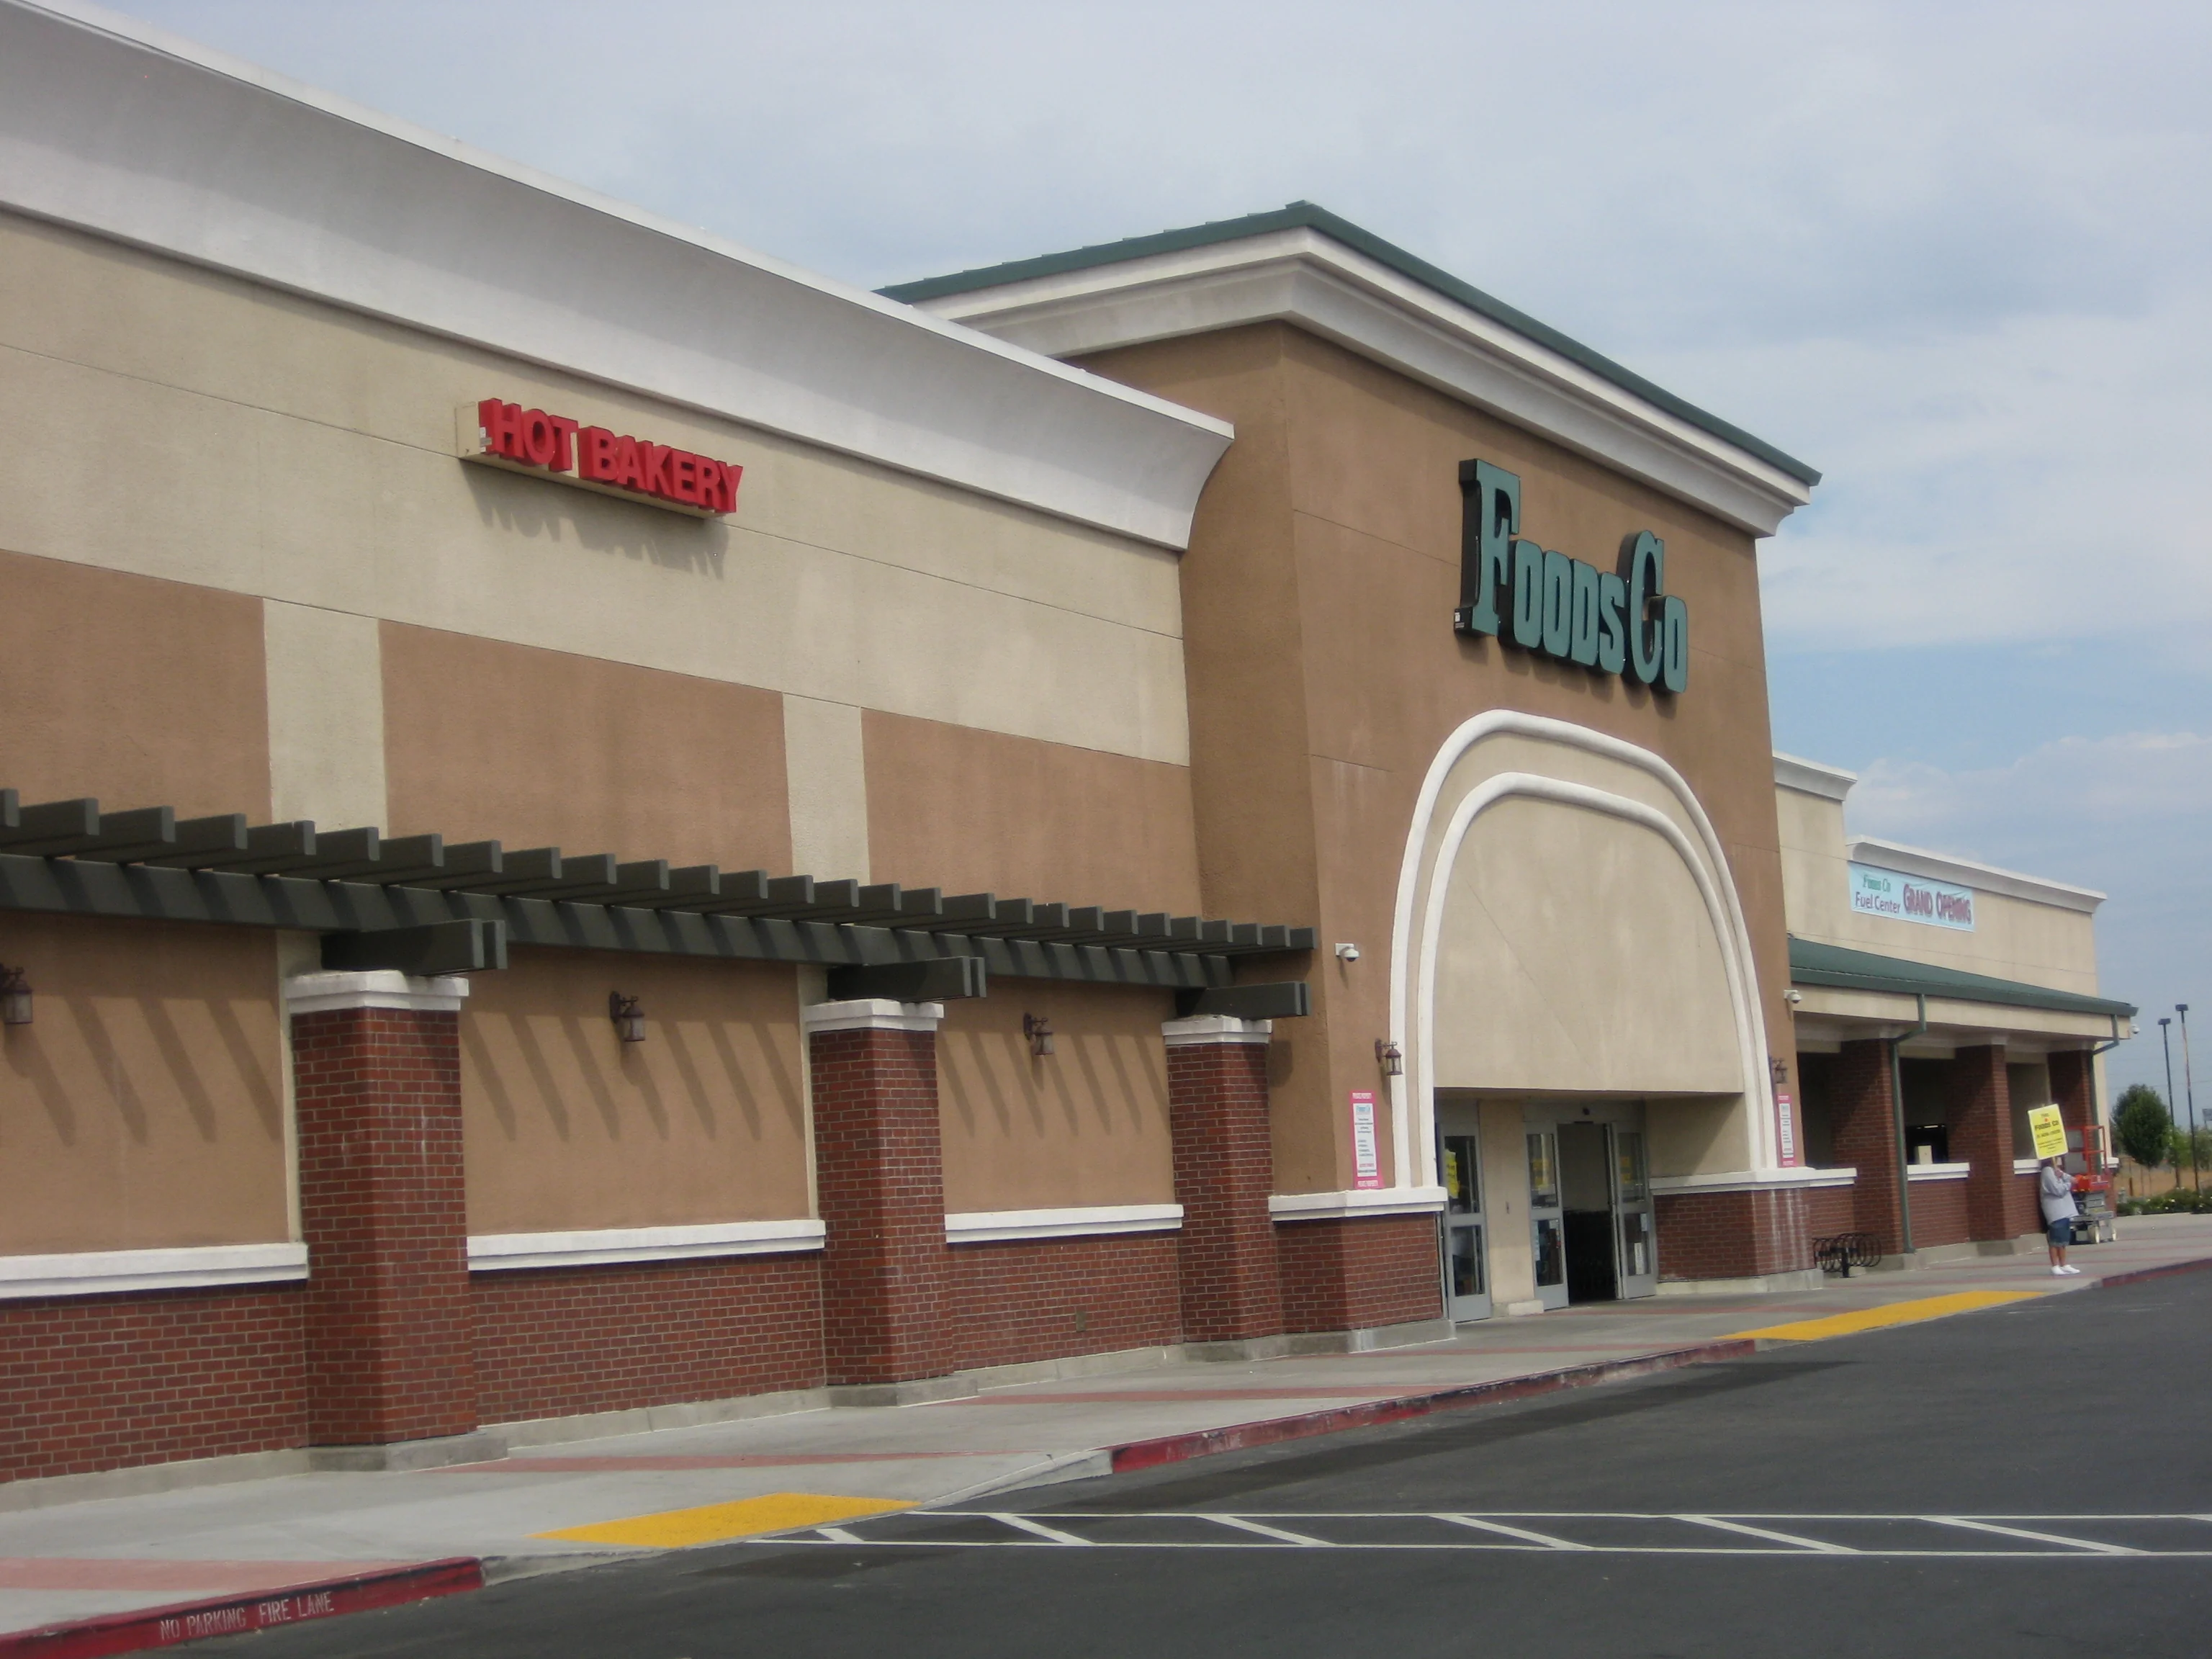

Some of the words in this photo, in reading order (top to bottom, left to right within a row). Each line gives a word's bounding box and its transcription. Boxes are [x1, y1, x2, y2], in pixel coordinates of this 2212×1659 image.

[479, 398, 578, 472] HOT
[579, 426, 743, 513] BAKERY
[1856, 891, 1874, 909] Fuel
[1875, 896, 1900, 914] Center
[1904, 884, 1933, 917] GRAND
[1936, 892, 1972, 925] OPENING
[160, 1619, 180, 1641] NO
[186, 1606, 246, 1637] PARKING
[258, 1598, 292, 1624] FIRE
[297, 1591, 335, 1618] LANE
